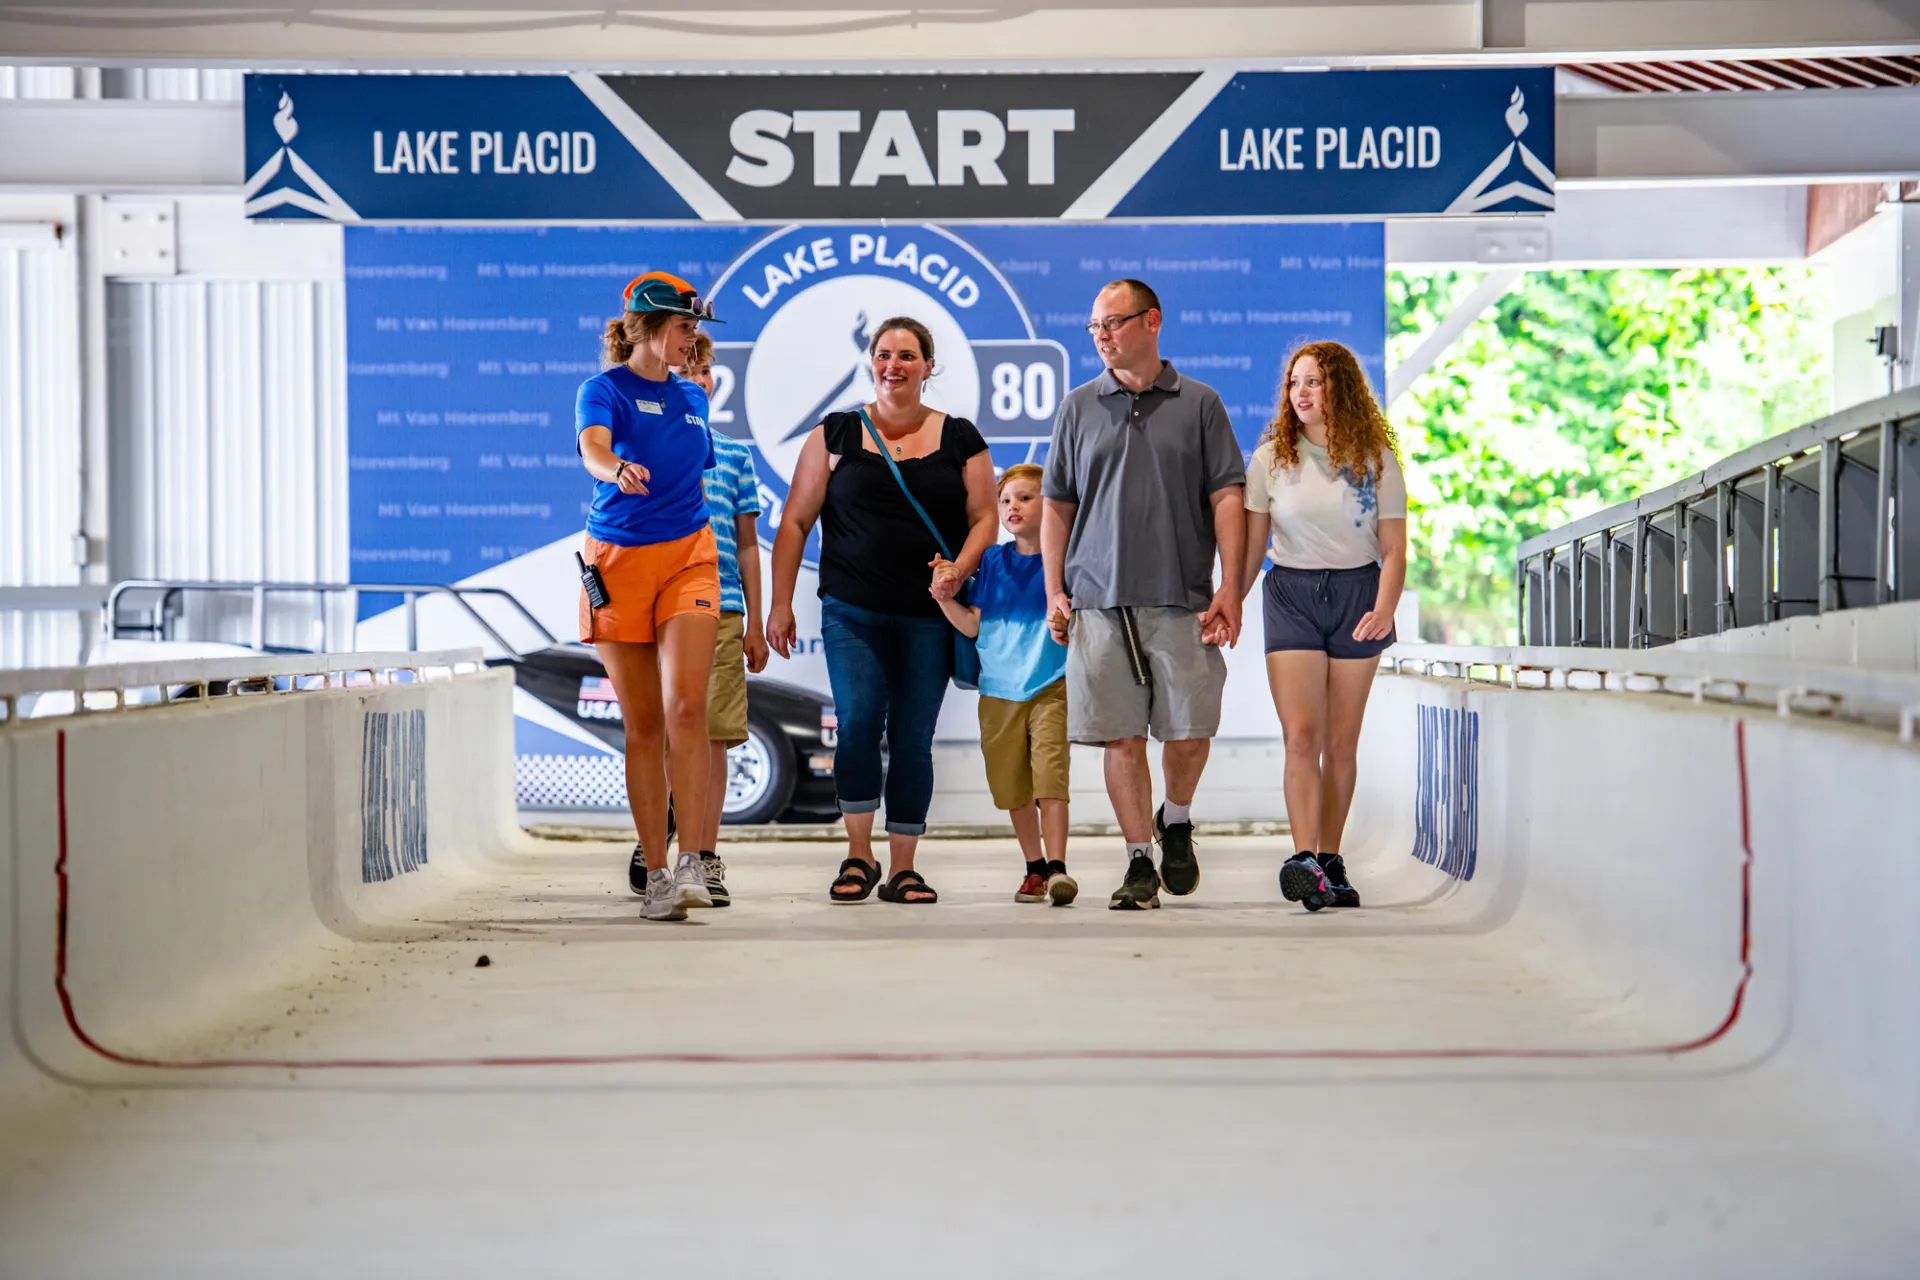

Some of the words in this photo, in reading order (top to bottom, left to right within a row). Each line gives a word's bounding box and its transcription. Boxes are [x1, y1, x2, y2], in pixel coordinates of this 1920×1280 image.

[373, 130, 460, 174] LAKE
[470, 130, 596, 174] PLACID
[725, 109, 1075, 187] START
[1220, 127, 1304, 171] LAKE
[1316, 125, 1441, 169] PLACID
[506, 262, 541, 277] Van
[742, 236, 838, 309] LAKE
[850, 234, 980, 308] PLACID
[404, 316, 439, 331] Van
[443, 314, 549, 334] Hoevenberg
[991, 362, 1056, 420] 80
[405, 410, 440, 425] Van
[577, 700, 623, 720] USA
